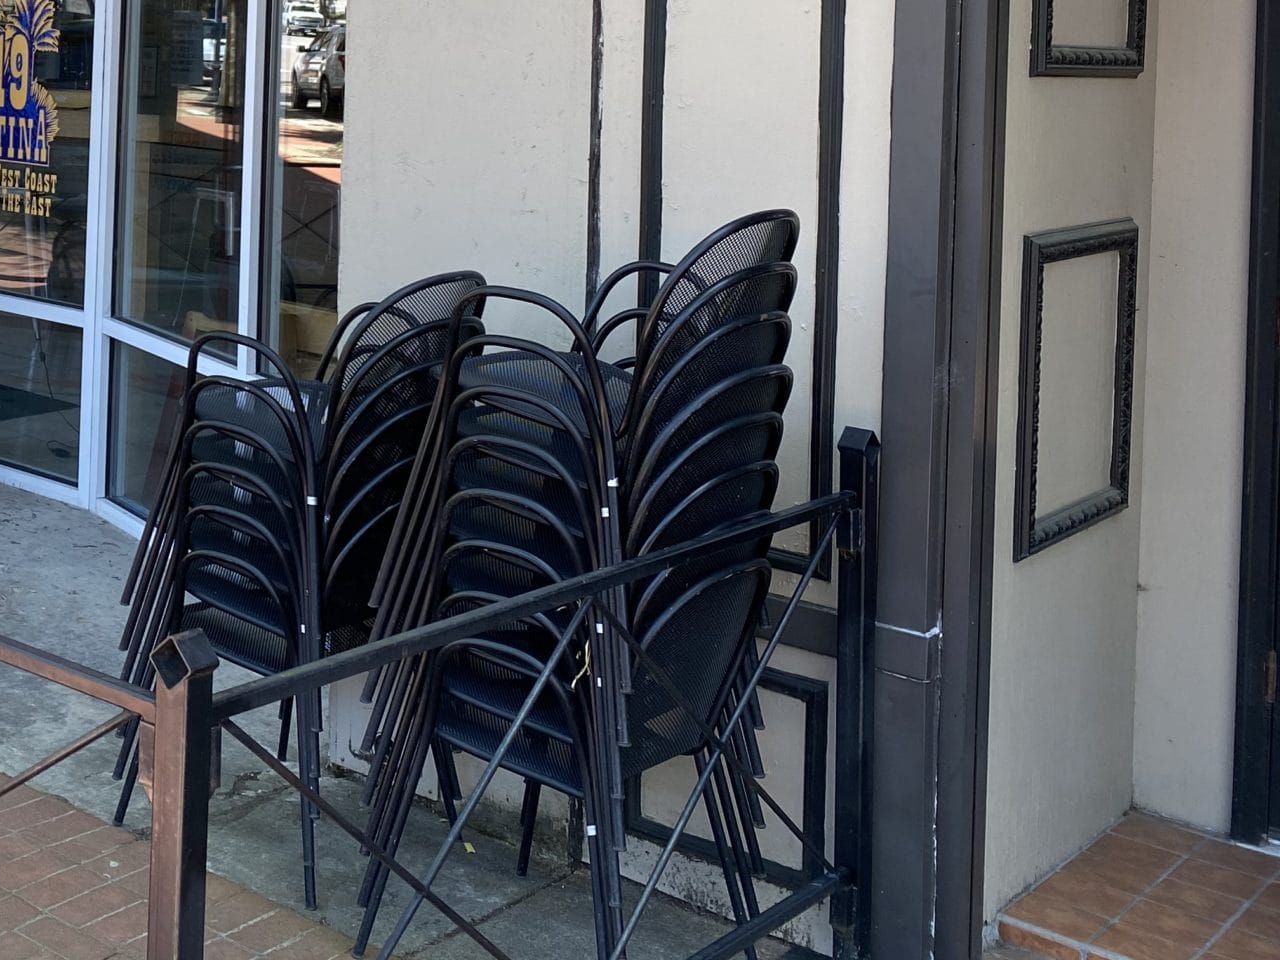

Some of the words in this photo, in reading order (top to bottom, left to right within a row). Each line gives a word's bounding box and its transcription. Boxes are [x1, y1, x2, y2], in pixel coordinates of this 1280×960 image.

[24, 167, 58, 194] COAST
[2, 188, 21, 214] THE
[24, 191, 52, 217] EAST
